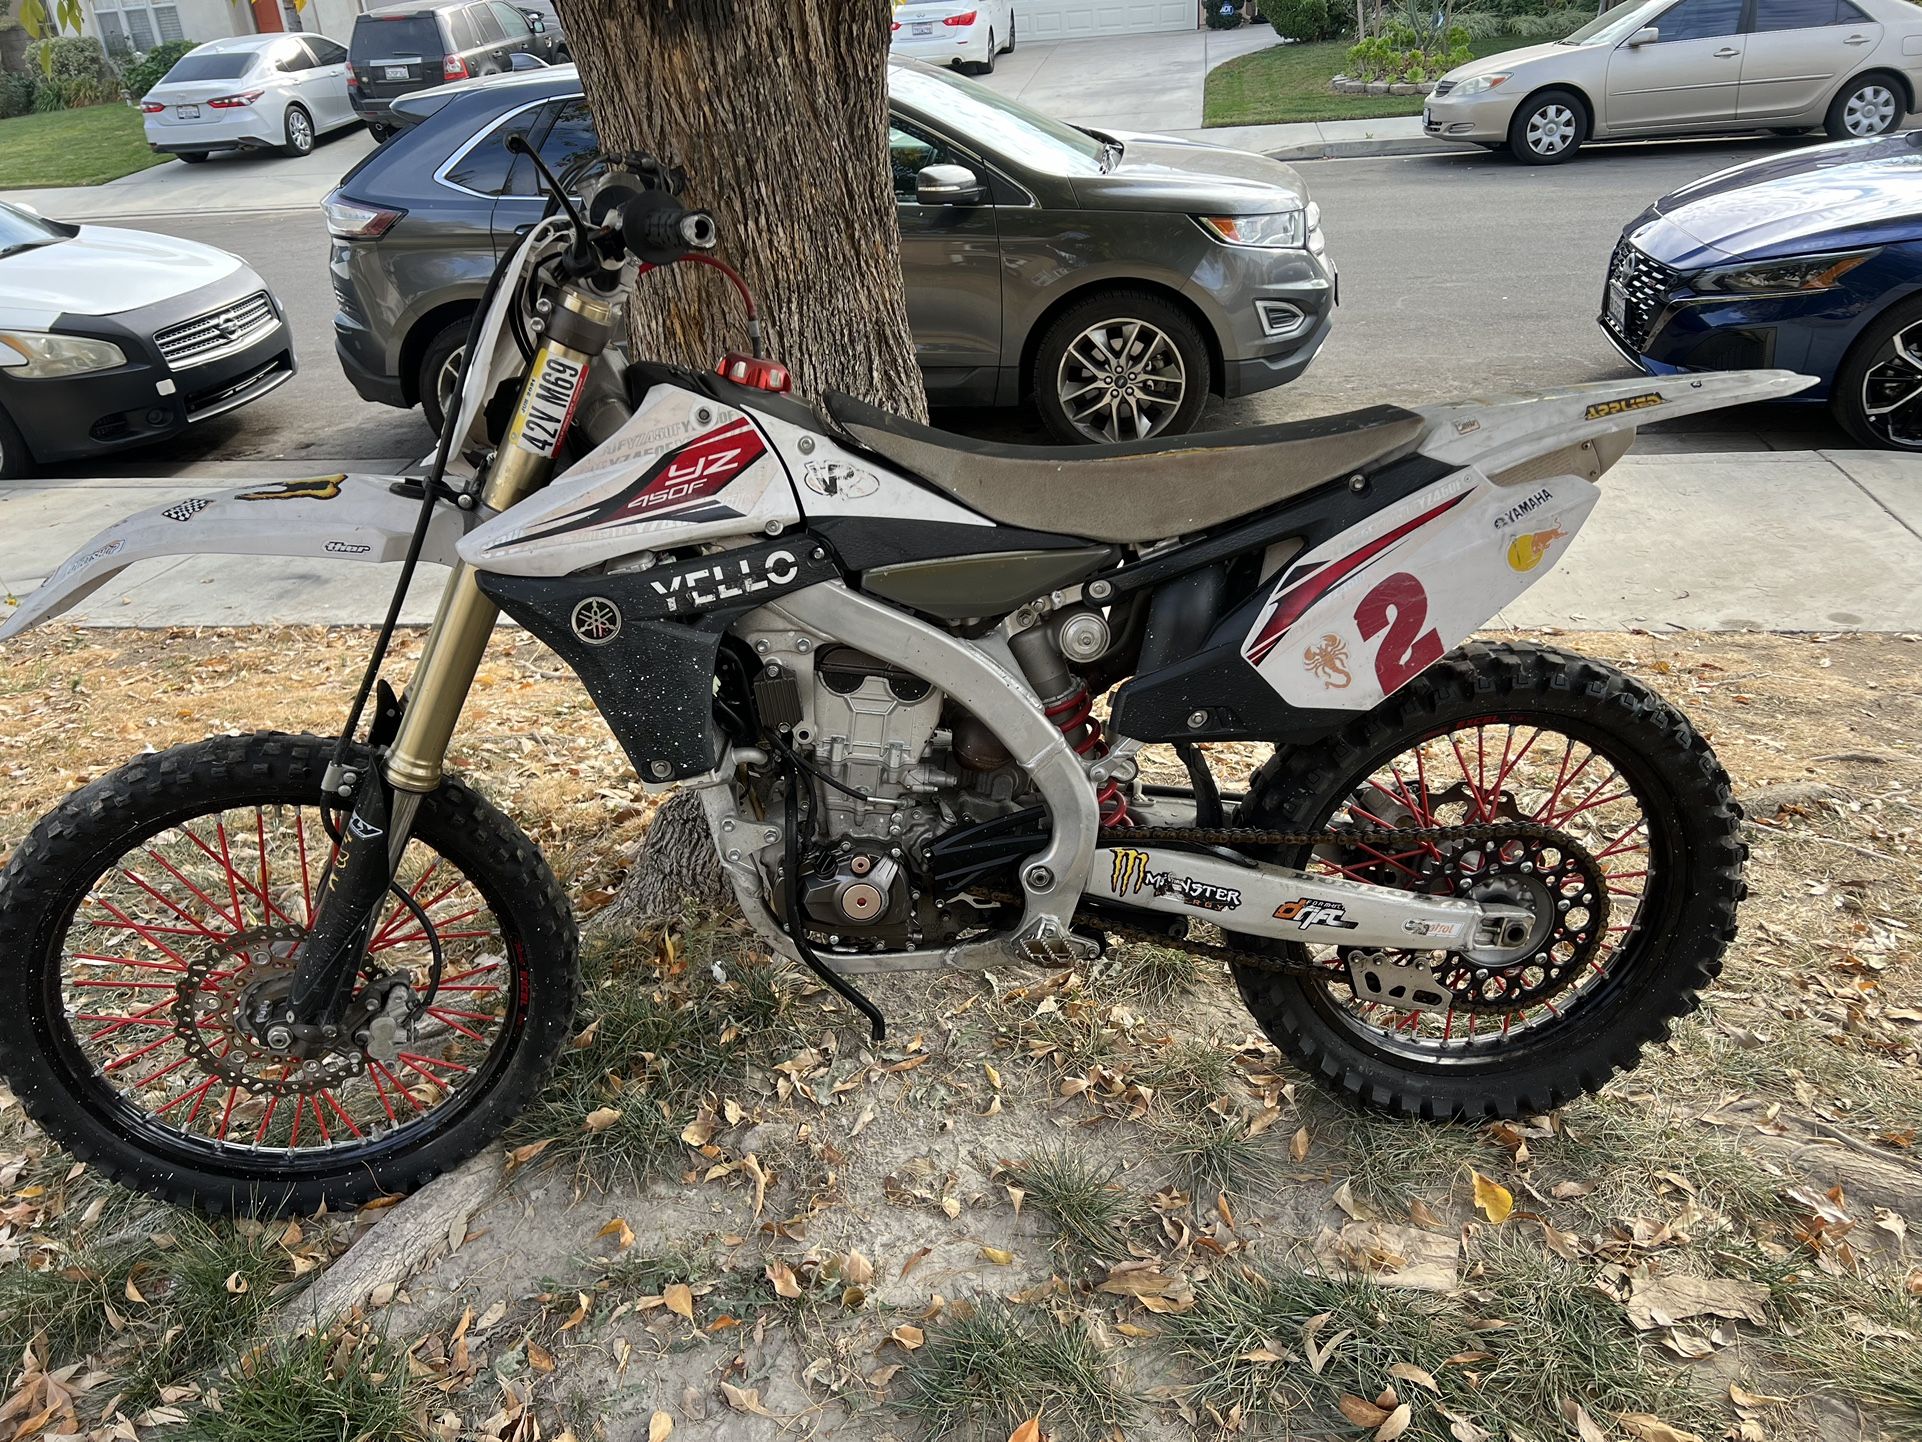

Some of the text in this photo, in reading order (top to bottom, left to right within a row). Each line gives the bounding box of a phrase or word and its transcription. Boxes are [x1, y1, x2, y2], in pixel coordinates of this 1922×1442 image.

[522, 359, 578, 451] 42V M69
[627, 478, 708, 509] 450F
[1506, 488, 1554, 528] YAMAHA
[1353, 571, 1445, 697] 2
[1144, 871, 1240, 905] MNSTER
